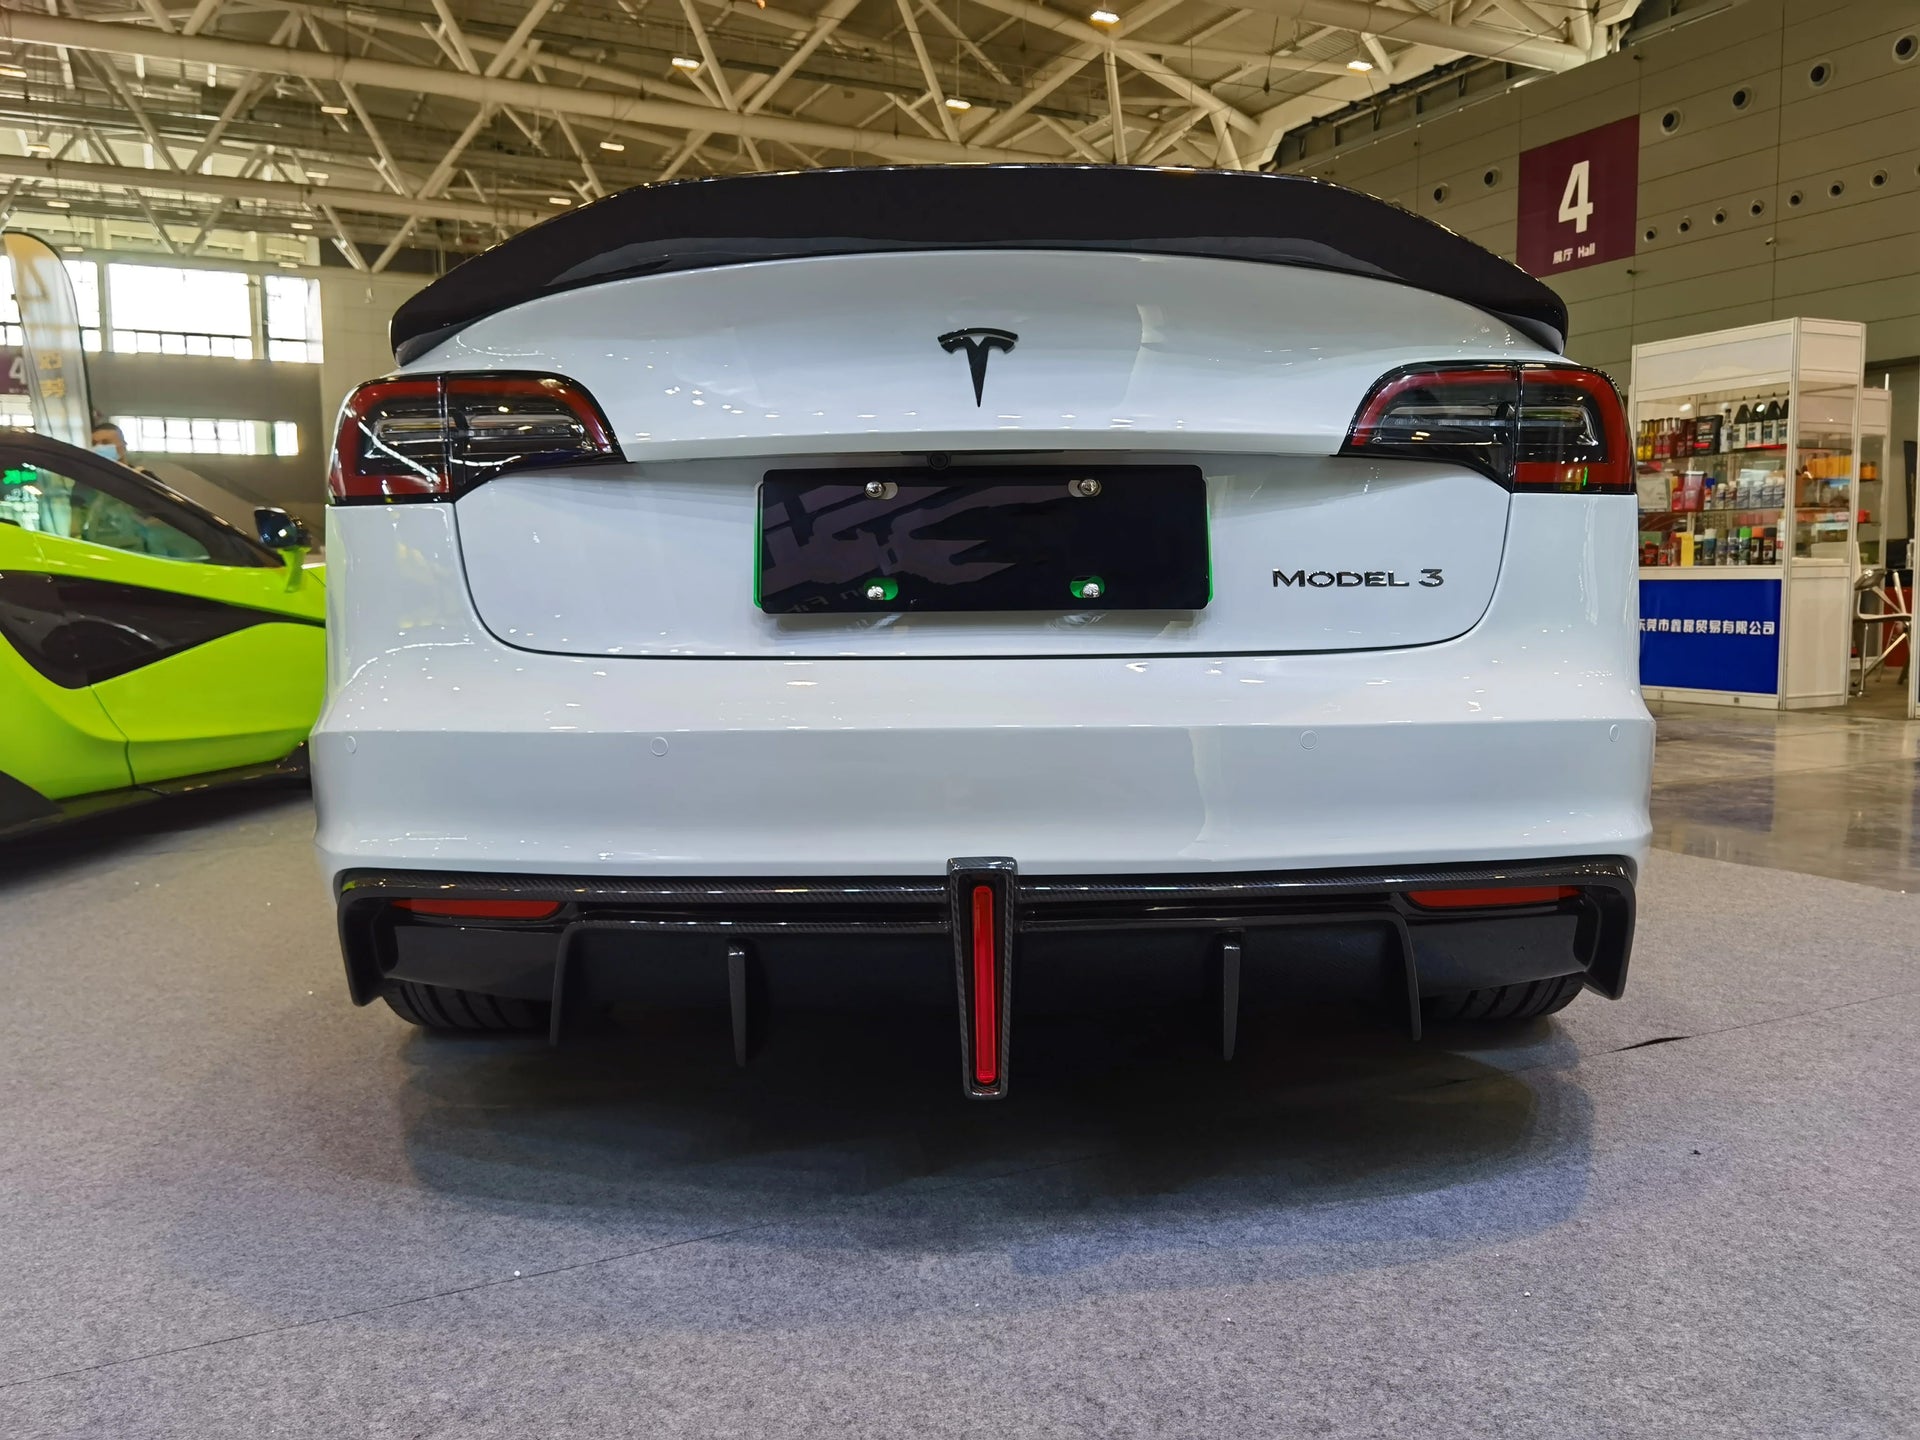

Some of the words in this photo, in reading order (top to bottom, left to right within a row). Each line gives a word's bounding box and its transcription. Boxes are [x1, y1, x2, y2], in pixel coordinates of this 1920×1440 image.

[1558, 160, 1594, 234] 4
[1577, 242, 1596, 259] Hall
[1272, 568, 1410, 588] MODEL
[1418, 568, 1445, 588] 3
